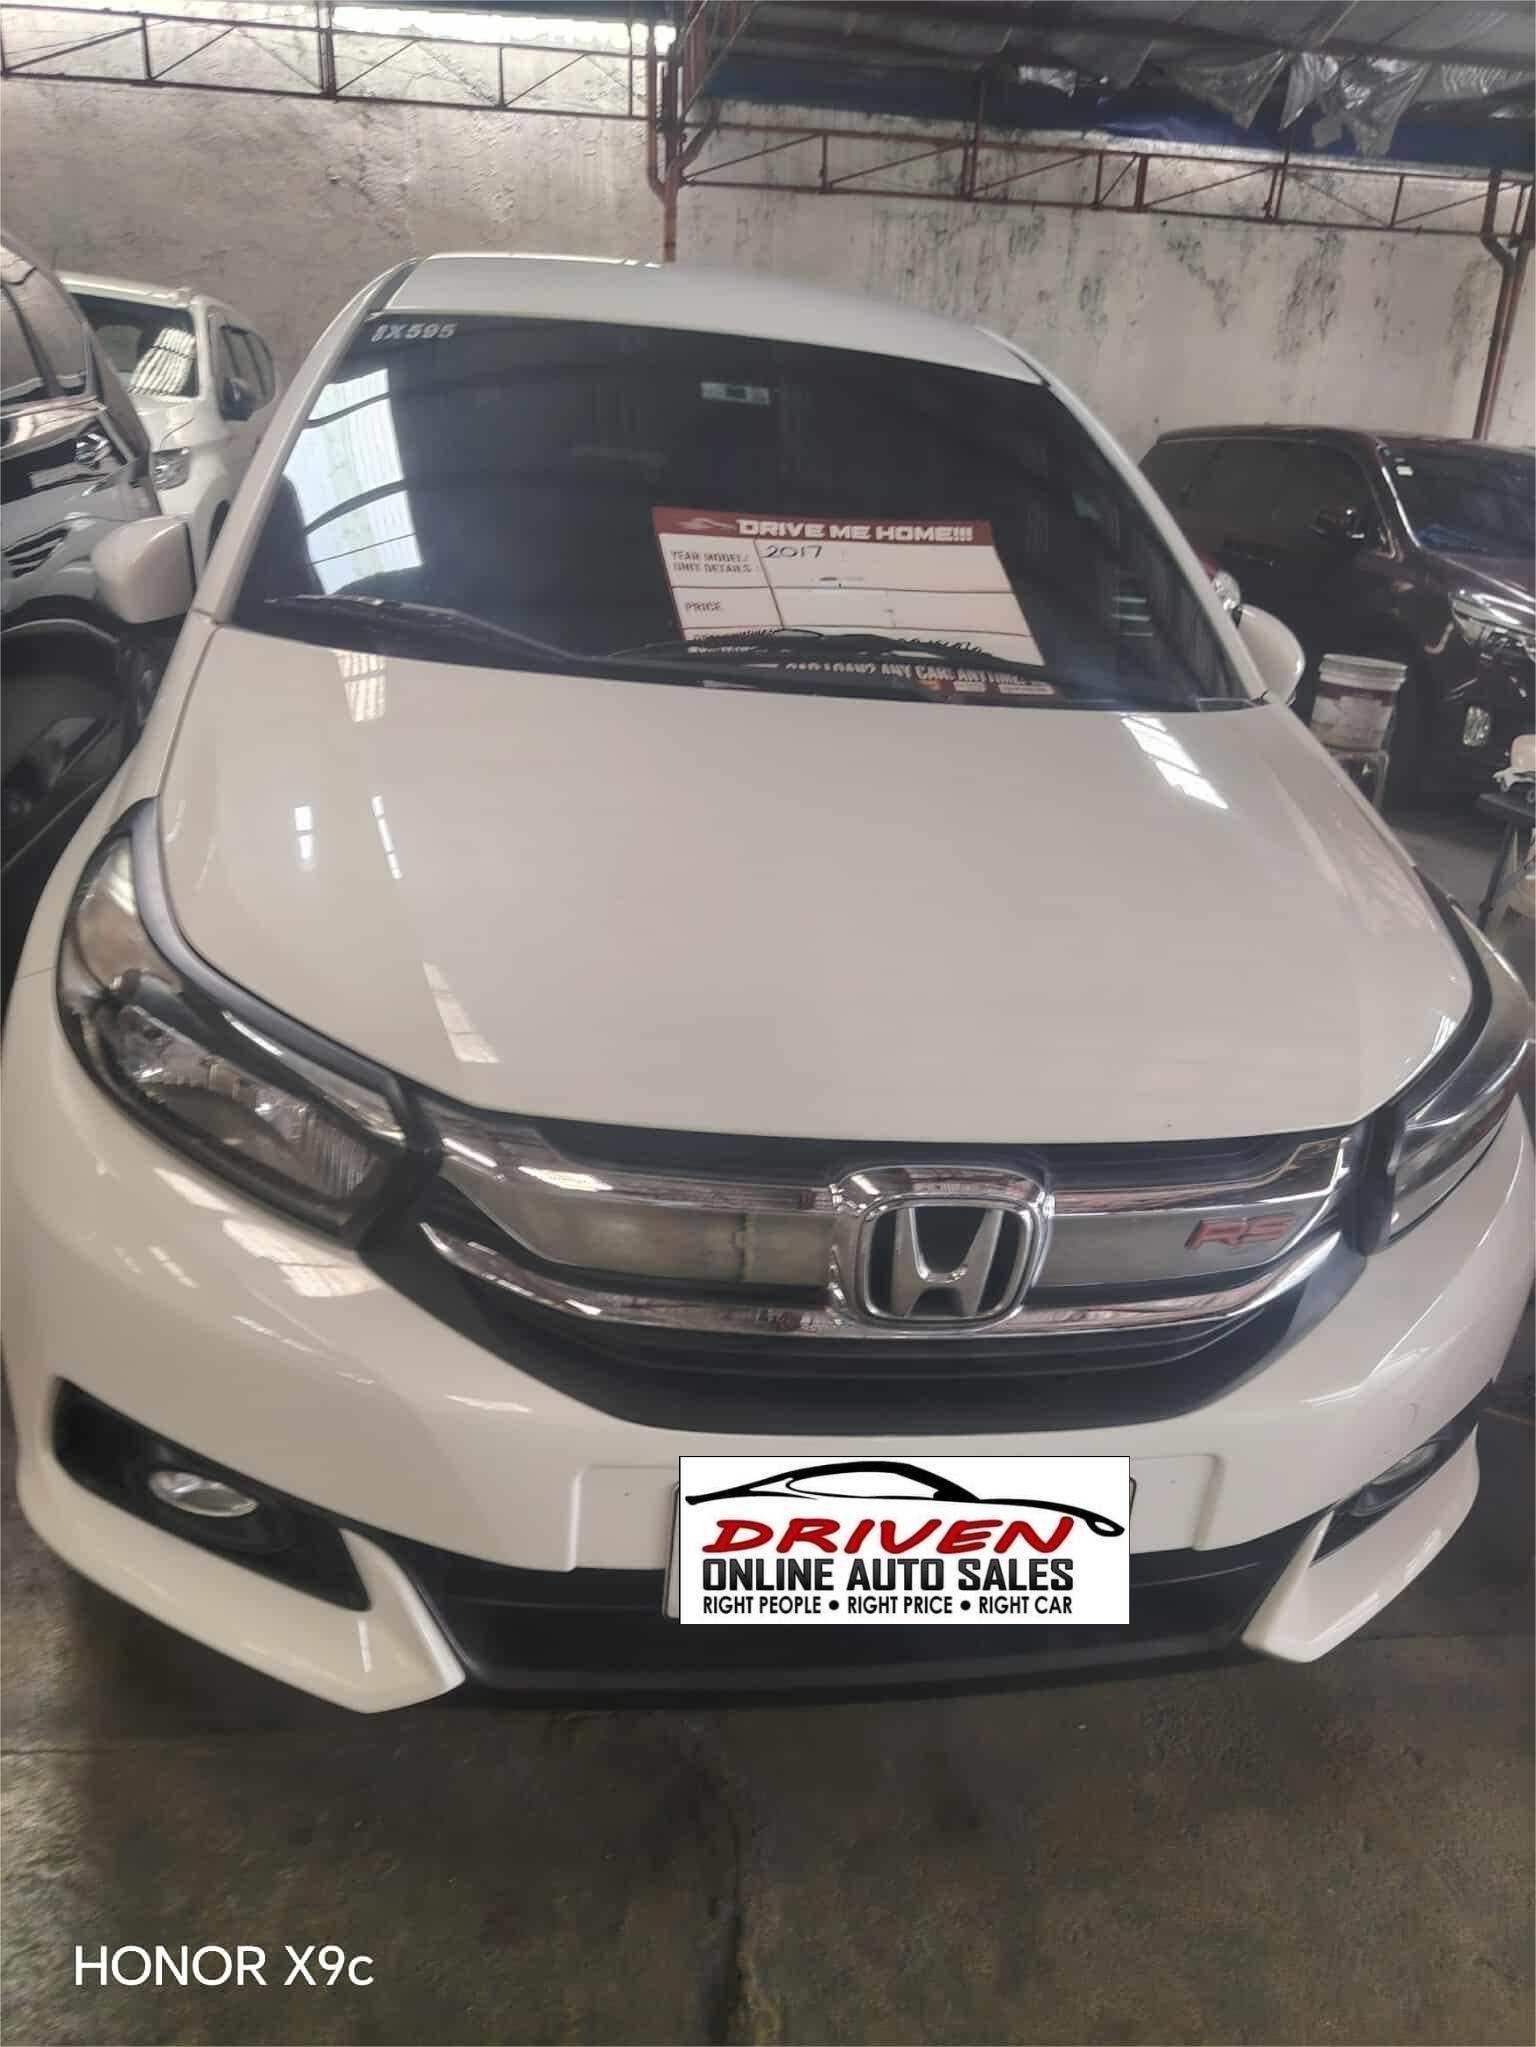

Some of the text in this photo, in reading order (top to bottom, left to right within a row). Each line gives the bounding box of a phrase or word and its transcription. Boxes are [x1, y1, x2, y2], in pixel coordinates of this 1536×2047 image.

[737, 519, 974, 542] DRIVE ME HOME!!!
[672, 551, 700, 560] YEAR
[767, 545, 822, 558] 2017
[686, 601, 721, 612] PRICE
[1184, 1215, 1292, 1248] RS
